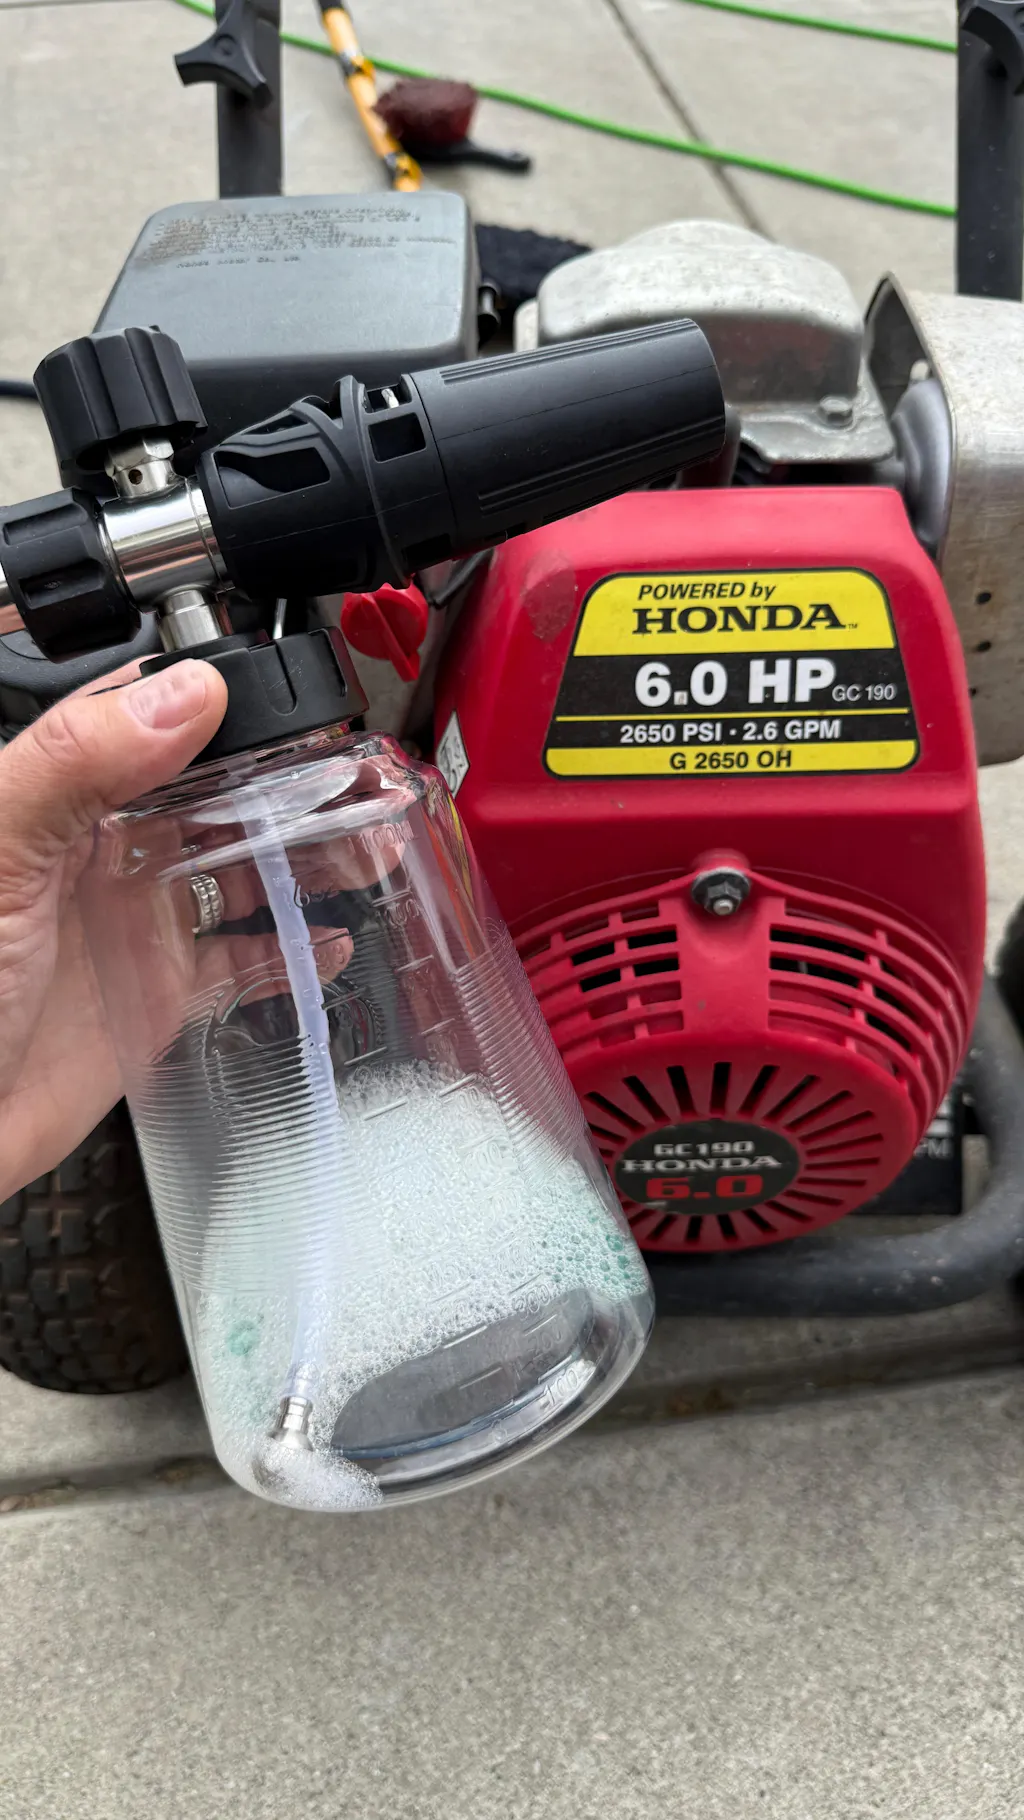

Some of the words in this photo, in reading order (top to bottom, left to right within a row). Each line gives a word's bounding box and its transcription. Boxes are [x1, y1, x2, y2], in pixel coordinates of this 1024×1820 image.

[638, 582, 745, 601] POWERED
[750, 582, 776, 601] by
[632, 603, 846, 635] HONDA
[635, 661, 728, 707] 6.0
[748, 658, 836, 704] HP
[832, 687, 861, 702] GC
[865, 684, 896, 701] 190
[620, 724, 676, 744] 2650
[682, 723, 722, 742] PSI
[742, 721, 777, 741] 2.6
[784, 720, 841, 740] GPM
[669, 754, 687, 771] G
[694, 752, 749, 770] 2650
[756, 750, 792, 768] OH
[621, 1155, 783, 1173] HONDA
[646, 1175, 763, 1199] 6.0
